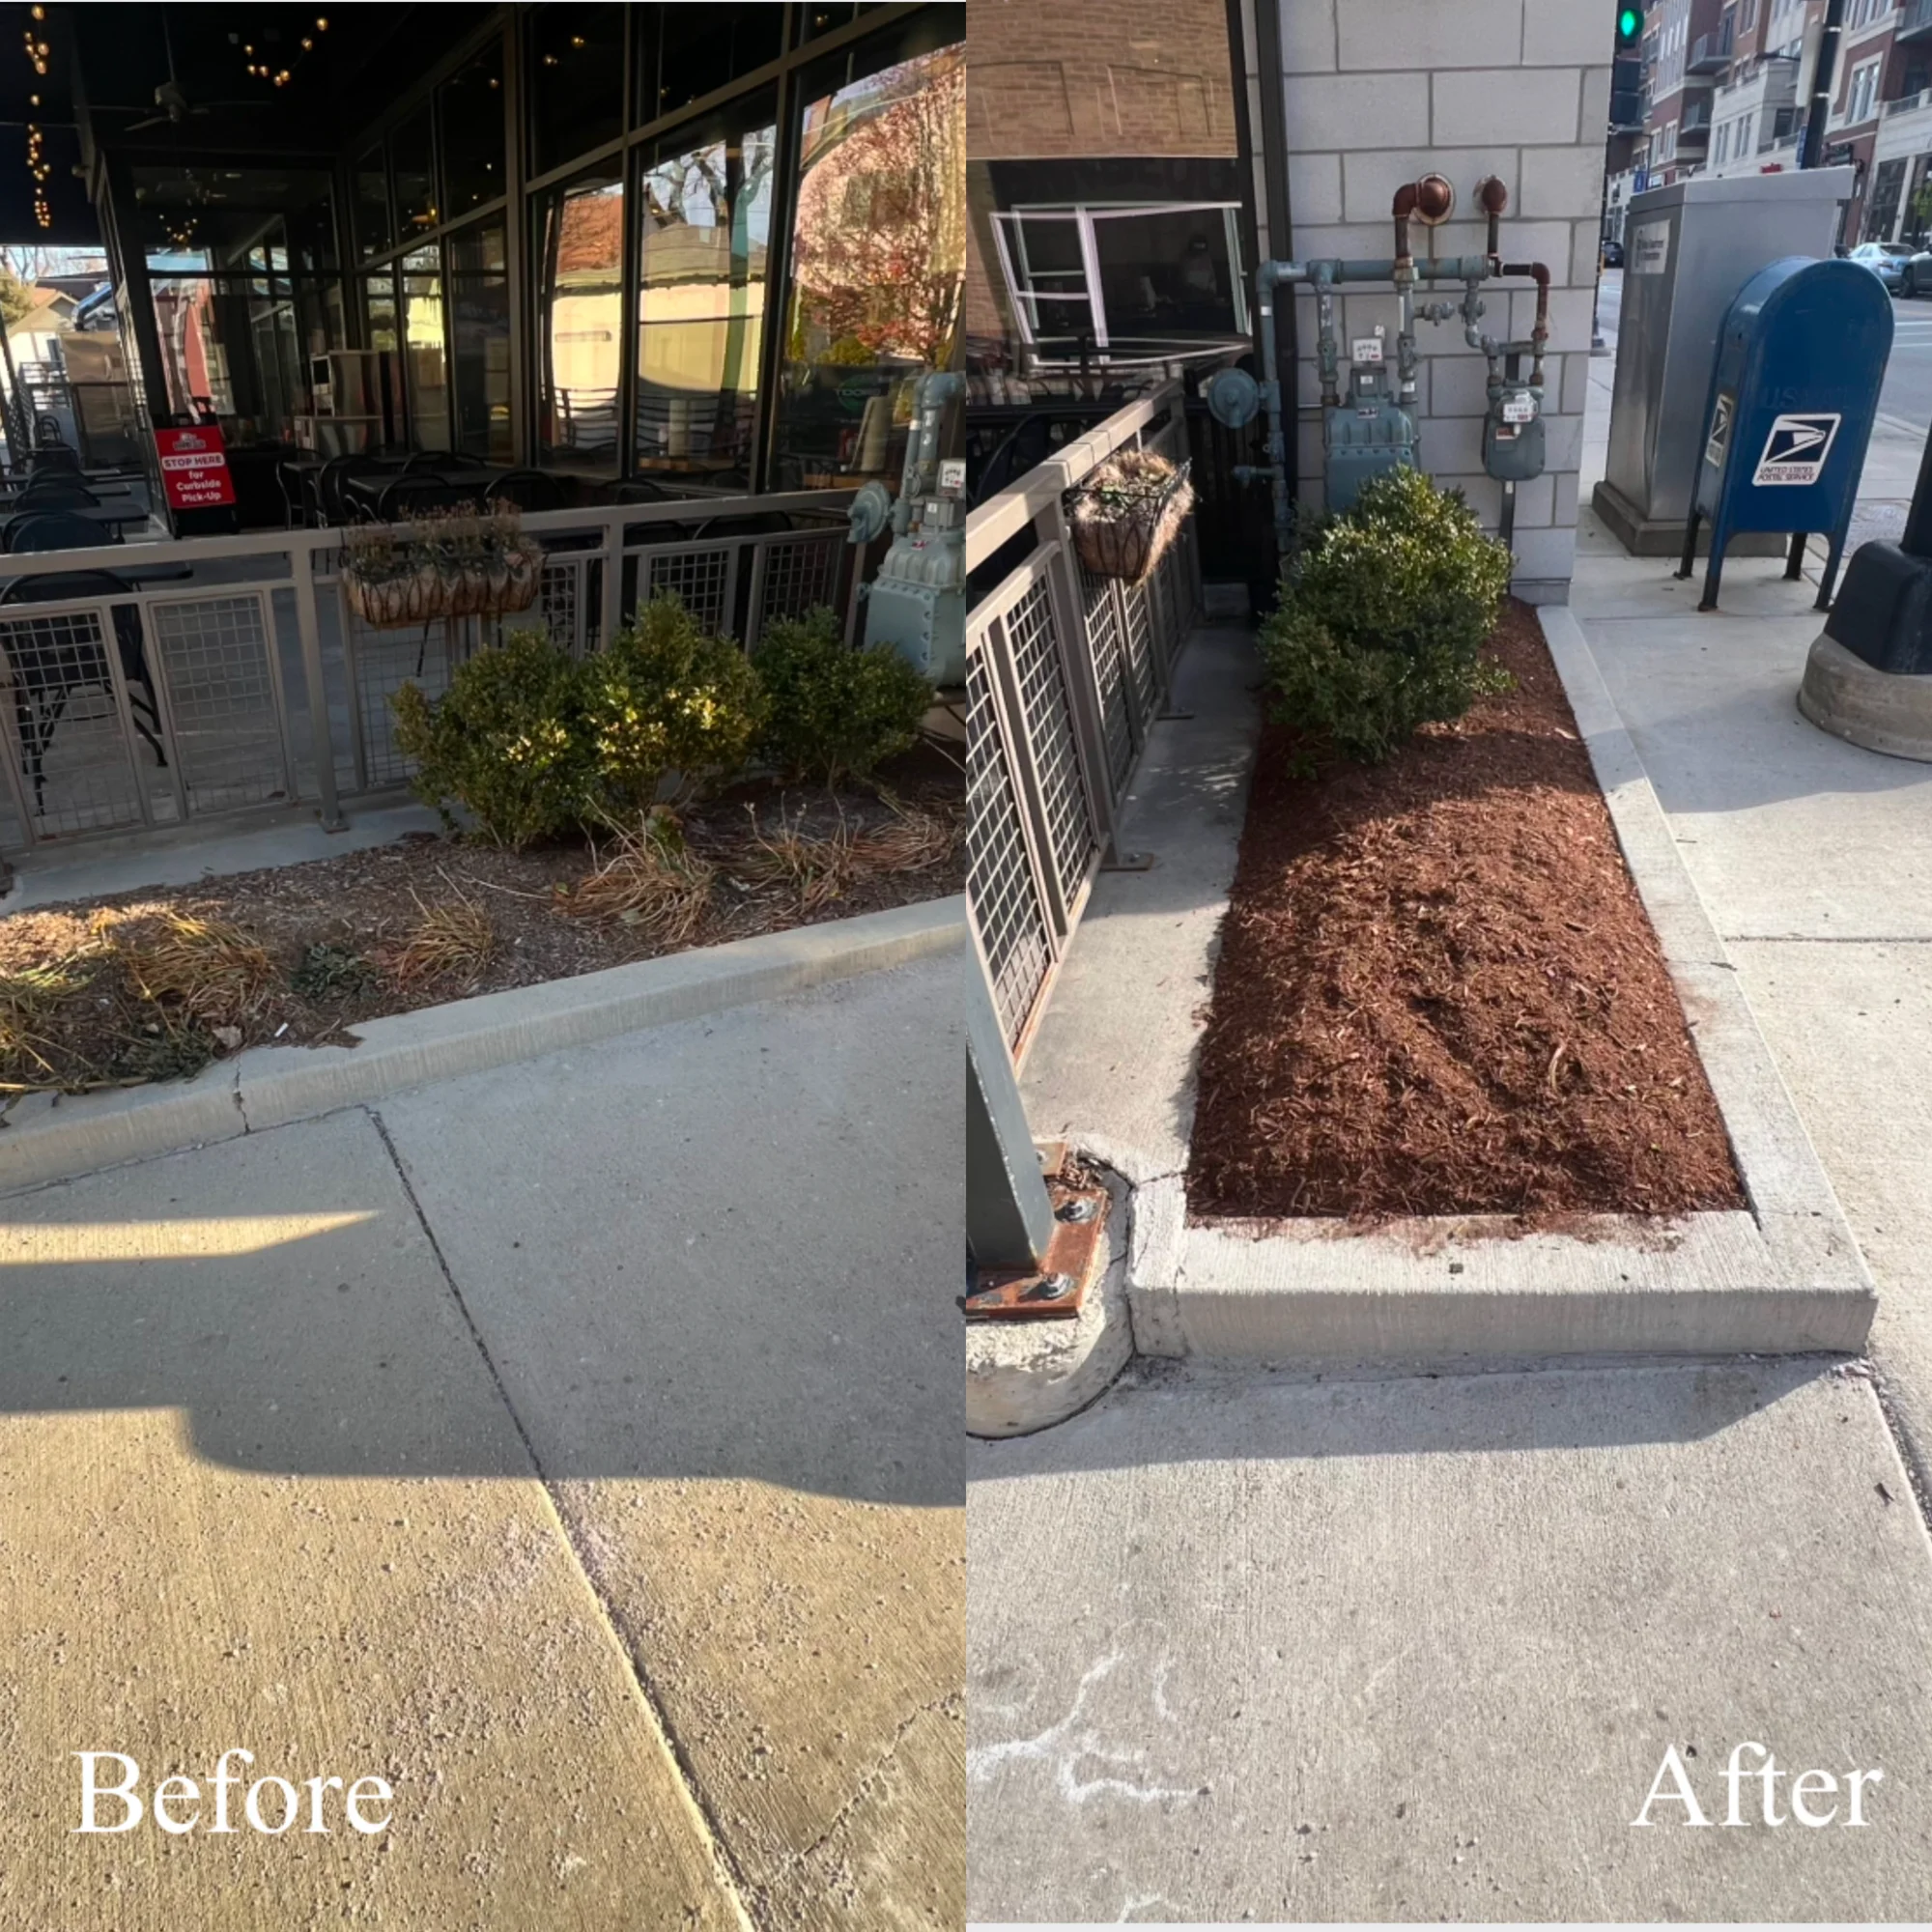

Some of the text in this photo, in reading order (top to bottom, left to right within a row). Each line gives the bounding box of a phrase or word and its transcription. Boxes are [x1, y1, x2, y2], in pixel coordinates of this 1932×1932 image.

[163, 455, 222, 469] STOP HERE
[188, 470, 204, 479] for
[176, 479, 221, 492] Curbside
[182, 492, 222, 502] Pick-Up
